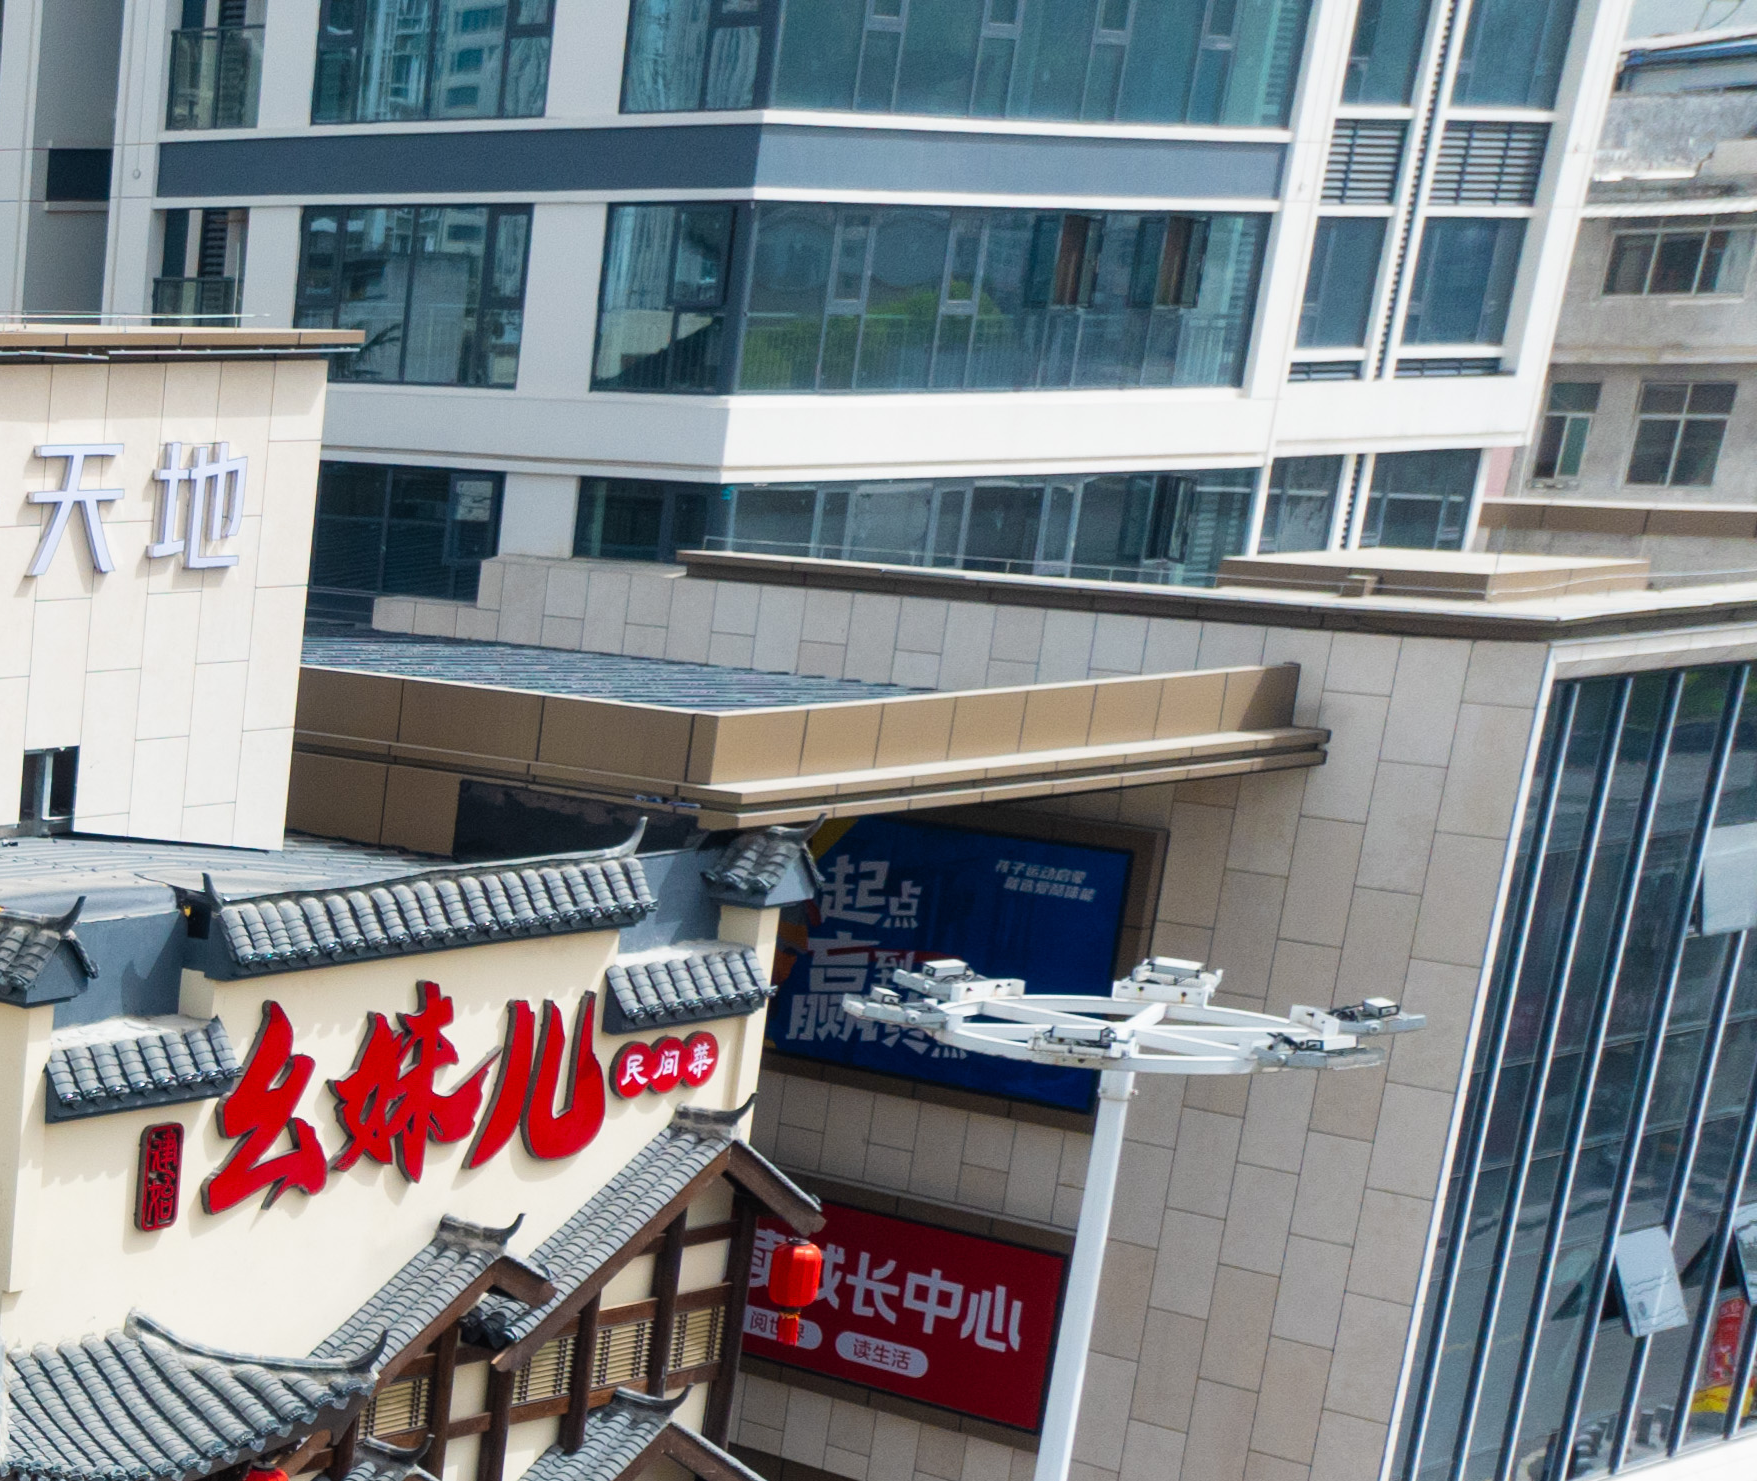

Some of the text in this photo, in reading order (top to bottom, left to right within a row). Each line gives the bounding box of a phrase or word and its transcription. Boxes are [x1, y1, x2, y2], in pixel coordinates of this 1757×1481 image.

[820, 855, 922, 929] 起点
[620, 1042, 713, 1086] 民间菜
[202, 980, 605, 1214] 幺妹儿
[852, 1339, 912, 1370] 读生活
